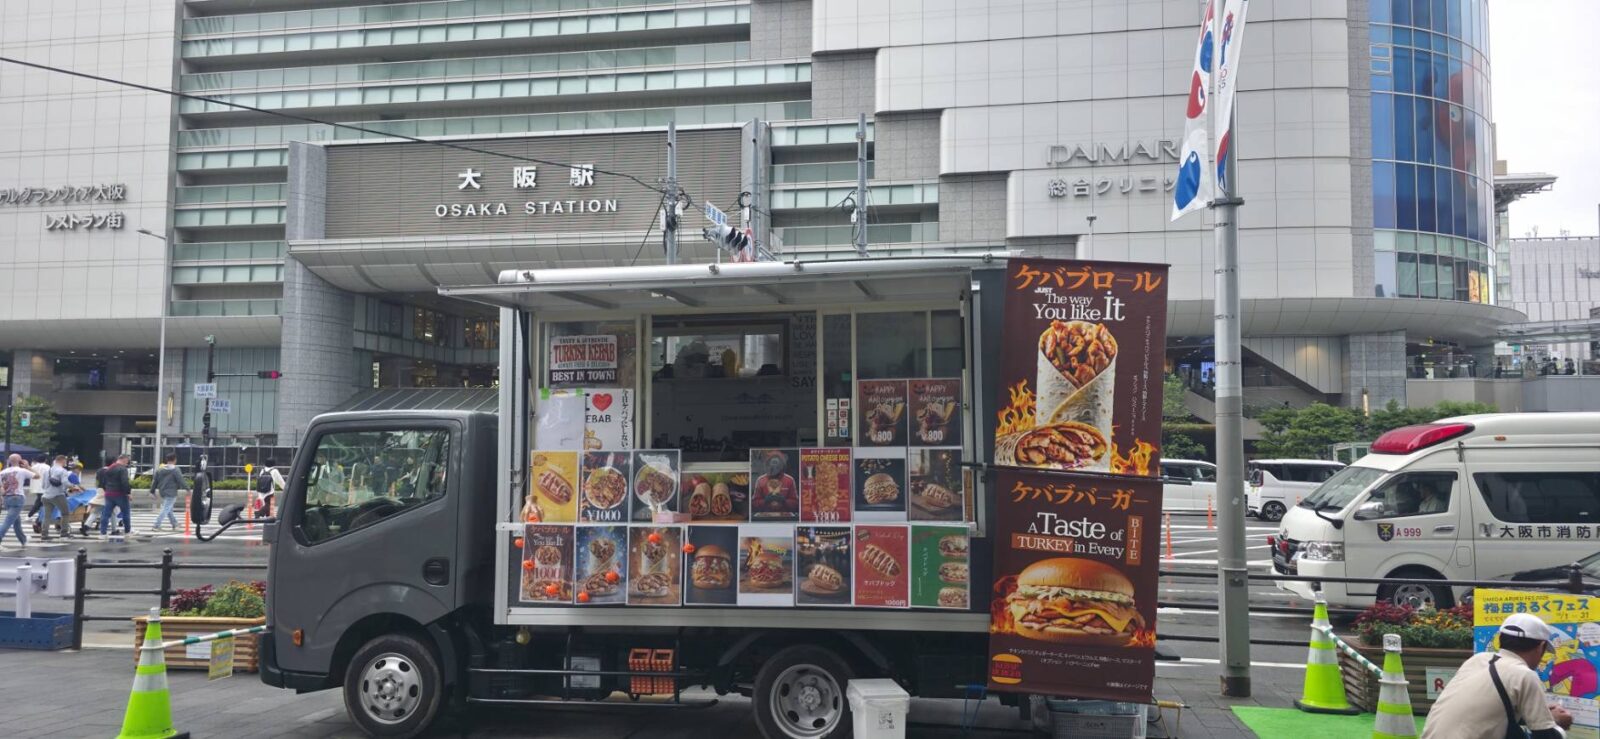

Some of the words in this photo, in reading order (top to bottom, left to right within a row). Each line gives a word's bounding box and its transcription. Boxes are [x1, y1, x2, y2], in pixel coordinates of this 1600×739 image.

[458, 164, 594, 190] 大阪駅
[1048, 177, 1177, 197] 総合クリニッ
[435, 203, 508, 217] OSAKA
[525, 199, 618, 214] STATION
[45, 212, 124, 230] レストラン街
[1014, 264, 1161, 292] ケバブロール
[1045, 293, 1067, 304] The
[1069, 296, 1093, 306] way
[1033, 304, 1067, 320] You
[1069, 304, 1101, 321] like
[553, 344, 586, 364] TURKISH
[588, 343, 616, 362] KEBAB
[552, 371, 575, 381] BEST
[576, 371, 585, 381] IN
[585, 414, 611, 423] EBAB
[1011, 480, 1149, 510] ケバブバーガー
[587, 510, 621, 521] ¥1000
[1027, 522, 1038, 534] A
[1037, 511, 1106, 540] Taste
[1110, 529, 1125, 541] of
[1403, 528, 1422, 537] 999
[1499, 525, 1600, 539] 大阪市消防
[1017, 535, 1073, 553] TURKEY
[1074, 540, 1086, 553] in
[1088, 542, 1125, 560] Every
[885, 599, 907, 607] 1000円
[1483, 598, 1589, 614] 梅田あるくフェス
